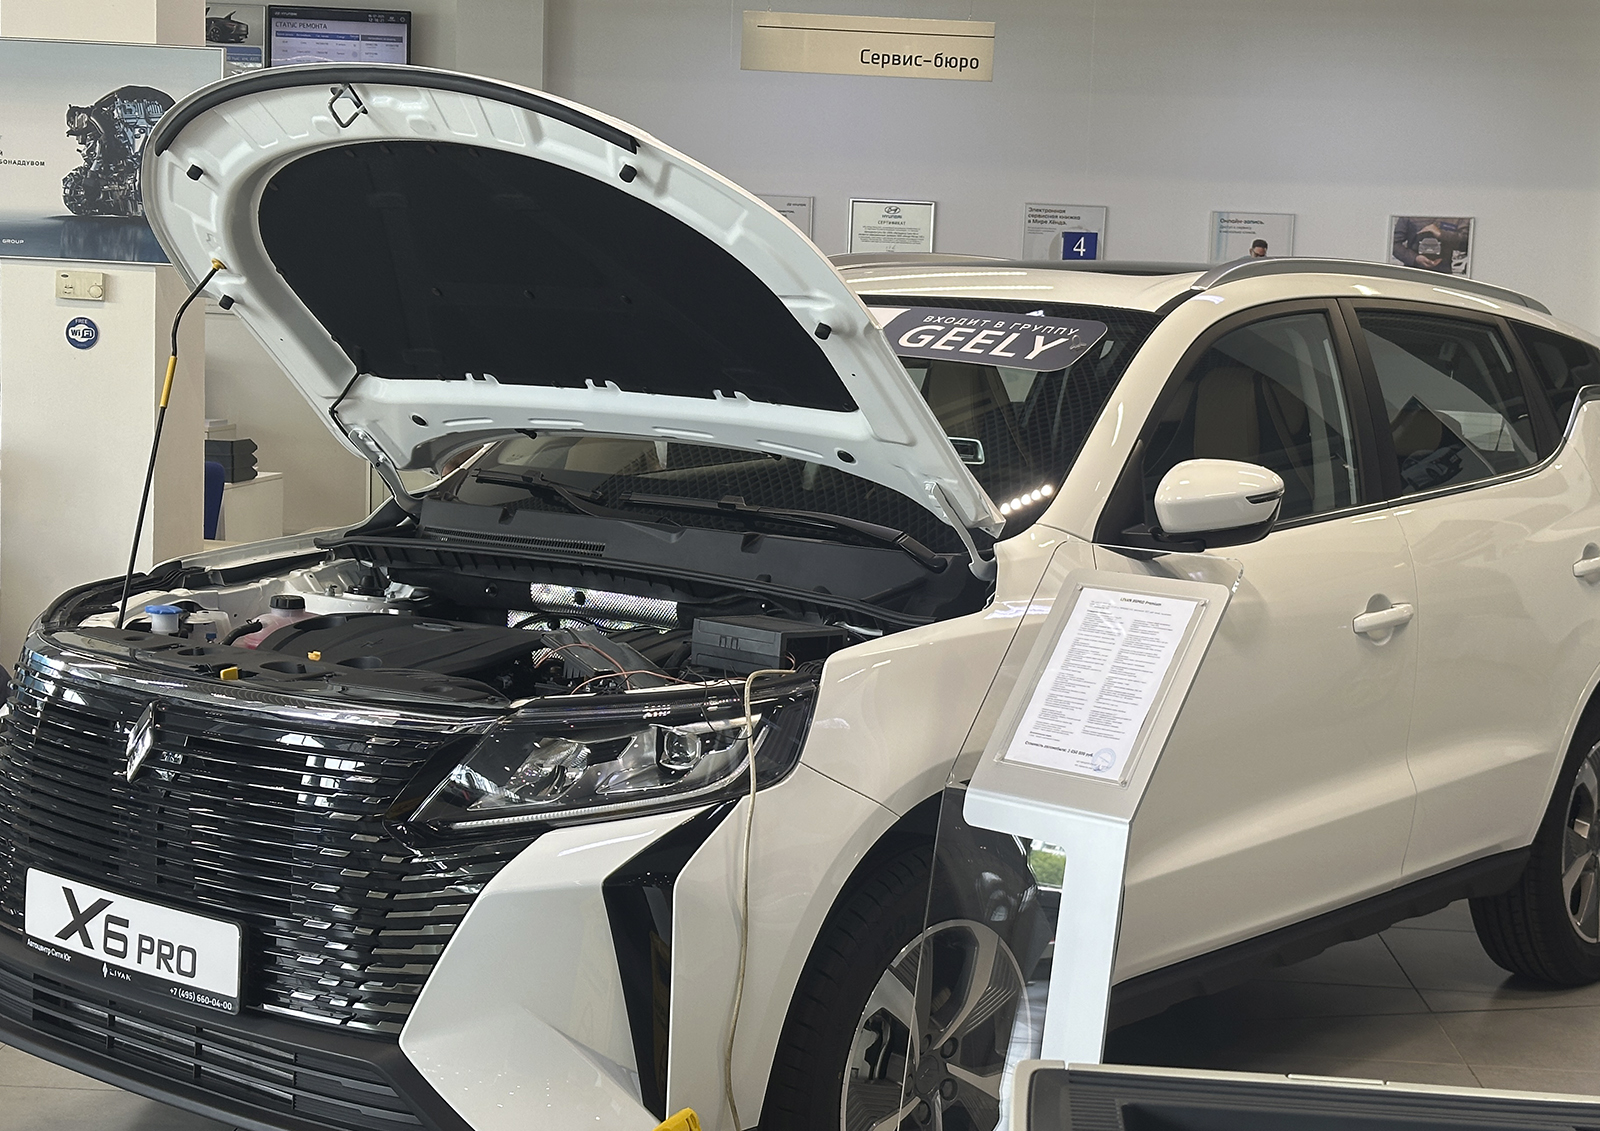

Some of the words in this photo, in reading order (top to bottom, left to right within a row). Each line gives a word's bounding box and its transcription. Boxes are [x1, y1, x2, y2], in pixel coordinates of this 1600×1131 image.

[275, 21, 298, 29] СТАТУС
[298, 22, 328, 30] РЕМОНТА
[860, 48, 980, 73] Сервис-бюро
[1028, 206, 1067, 214] Электронная
[1072, 236, 1087, 257] 4
[922, 314, 991, 329] ВХОДИТ
[993, 320, 1006, 329] В
[1009, 321, 1080, 337] ГРУППУ
[898, 324, 1070, 361] GEELY
[136, 933, 197, 979] PRO
[169, 987, 178, 996] +7
[178, 987, 196, 1002] (495)
[196, 994, 233, 1011] 660-04-00
